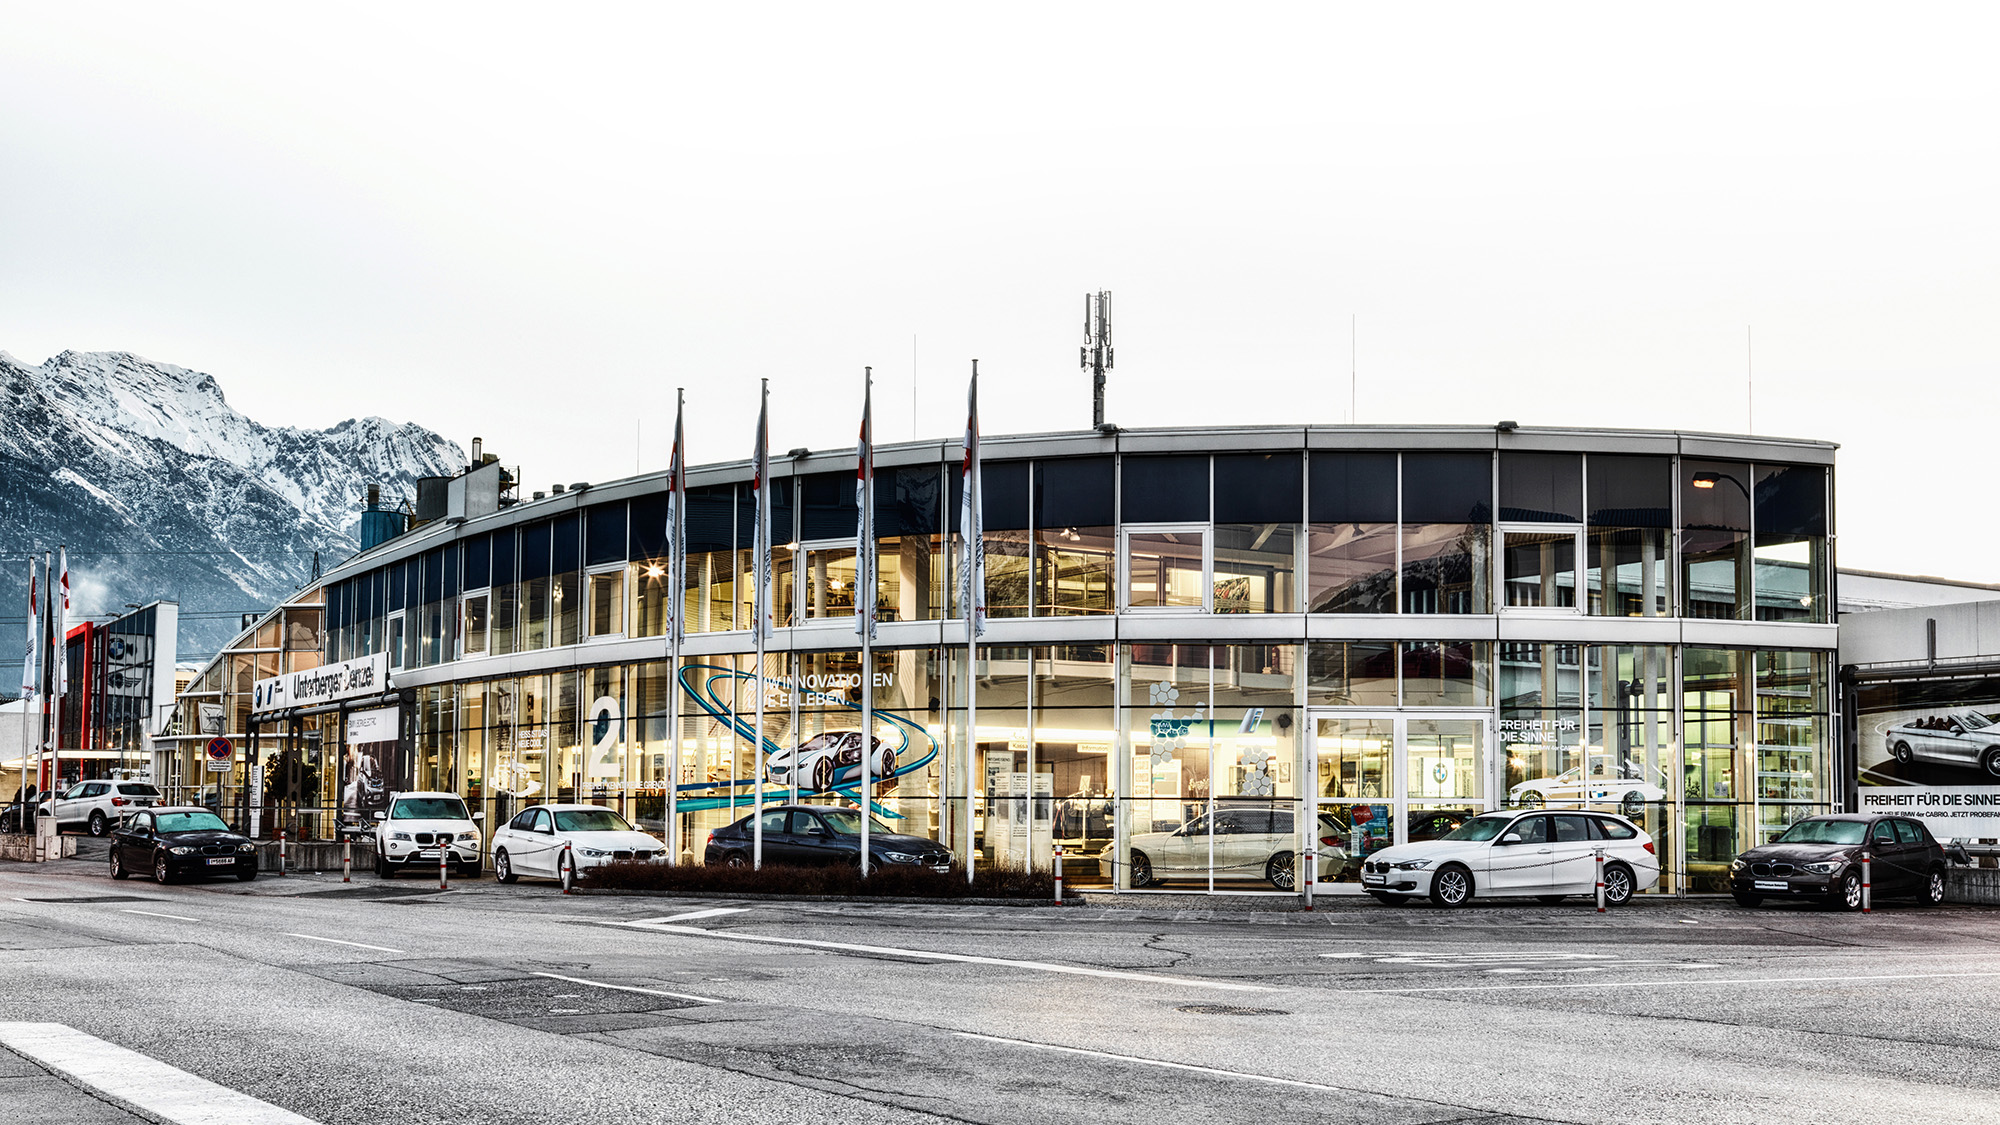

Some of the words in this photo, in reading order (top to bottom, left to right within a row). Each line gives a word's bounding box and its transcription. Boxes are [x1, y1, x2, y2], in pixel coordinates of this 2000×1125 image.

[293, 671, 342, 700] Unterberger
[344, 658, 374, 691] Denzel
[783, 673, 892, 690] INNOVATIOEN
[747, 694, 776, 709] LVE
[1499, 719, 1550, 731] FREIHEIT
[1552, 718, 1575, 731] FÜR
[588, 695, 620, 777] 2
[1499, 731, 1517, 742] DIE
[1519, 731, 1557, 743] SINNE.
[1864, 795, 1914, 806] FREIHEIT
[1917, 792, 1940, 806] FÜR
[1943, 794, 1962, 806] DIE
[1964, 794, 2000, 806] SINNE
